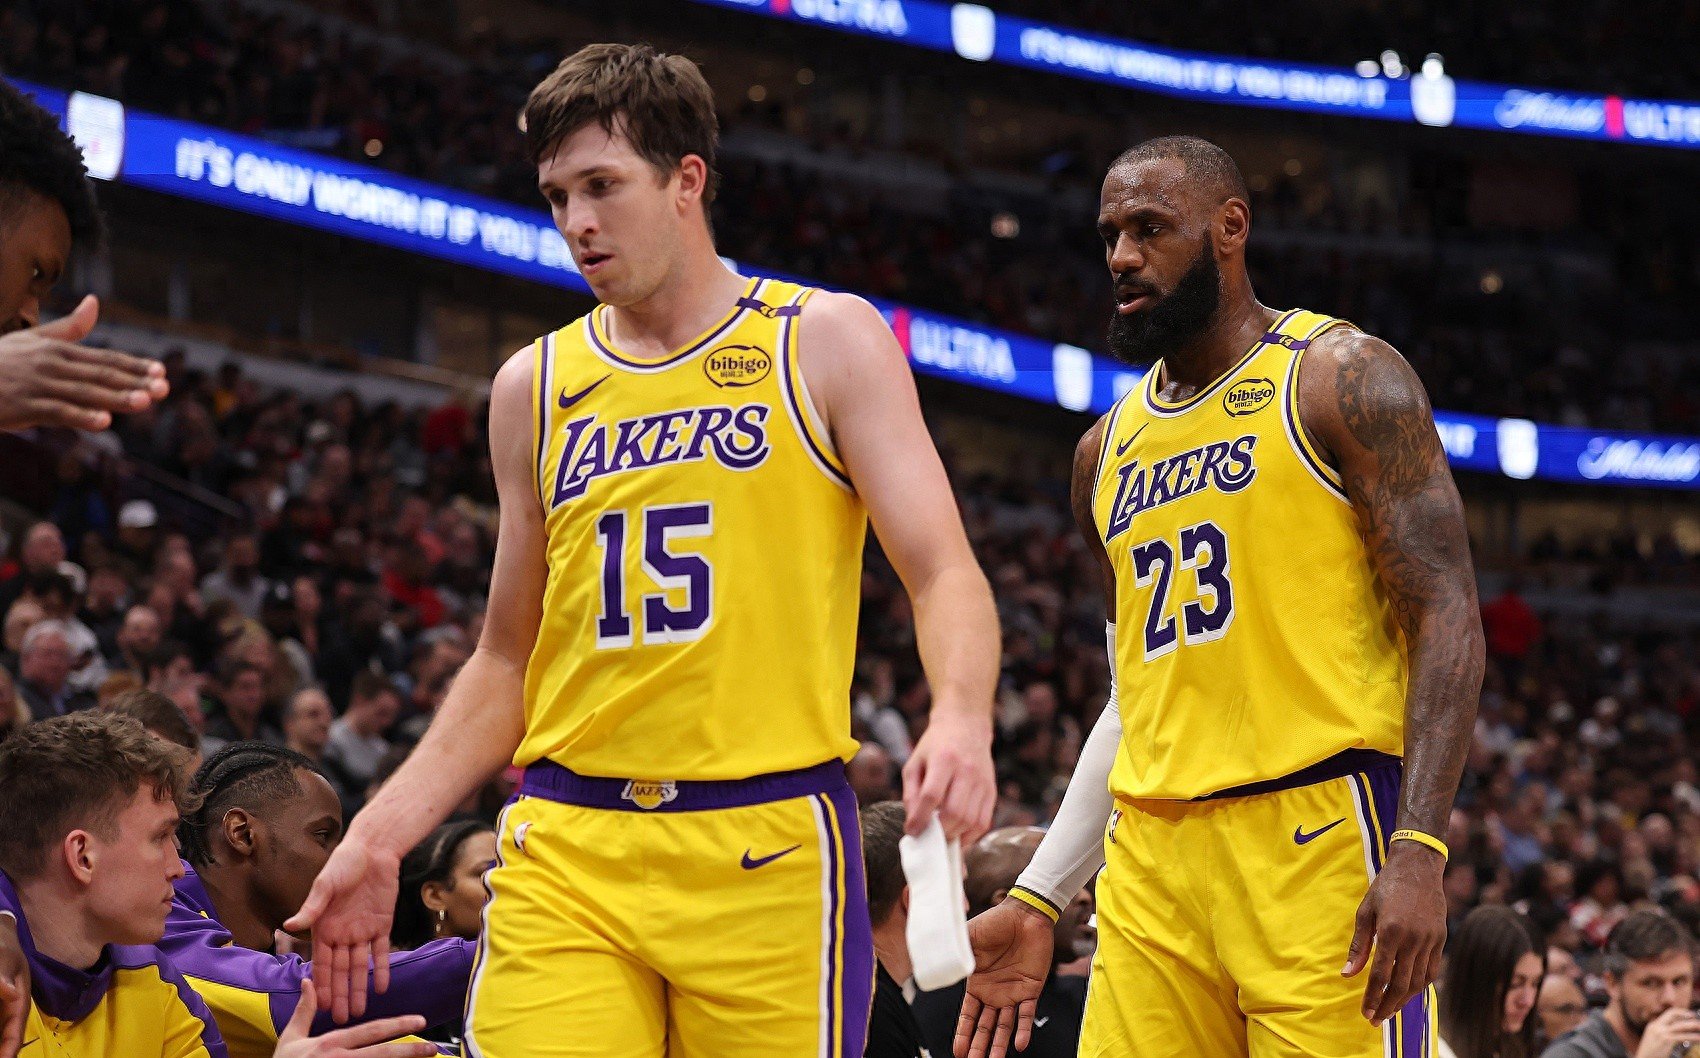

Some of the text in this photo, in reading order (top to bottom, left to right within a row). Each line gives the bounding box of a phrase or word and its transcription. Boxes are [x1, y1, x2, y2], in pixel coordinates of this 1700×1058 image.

[175, 137, 235, 188] IT'S
[710, 356, 768, 375] bibigo
[1228, 387, 1273, 403] bibigo
[550, 404, 773, 510] LAKERS
[1105, 433, 1259, 547] LAKERS
[596, 501, 713, 649] 15
[1130, 519, 1236, 663] 23
